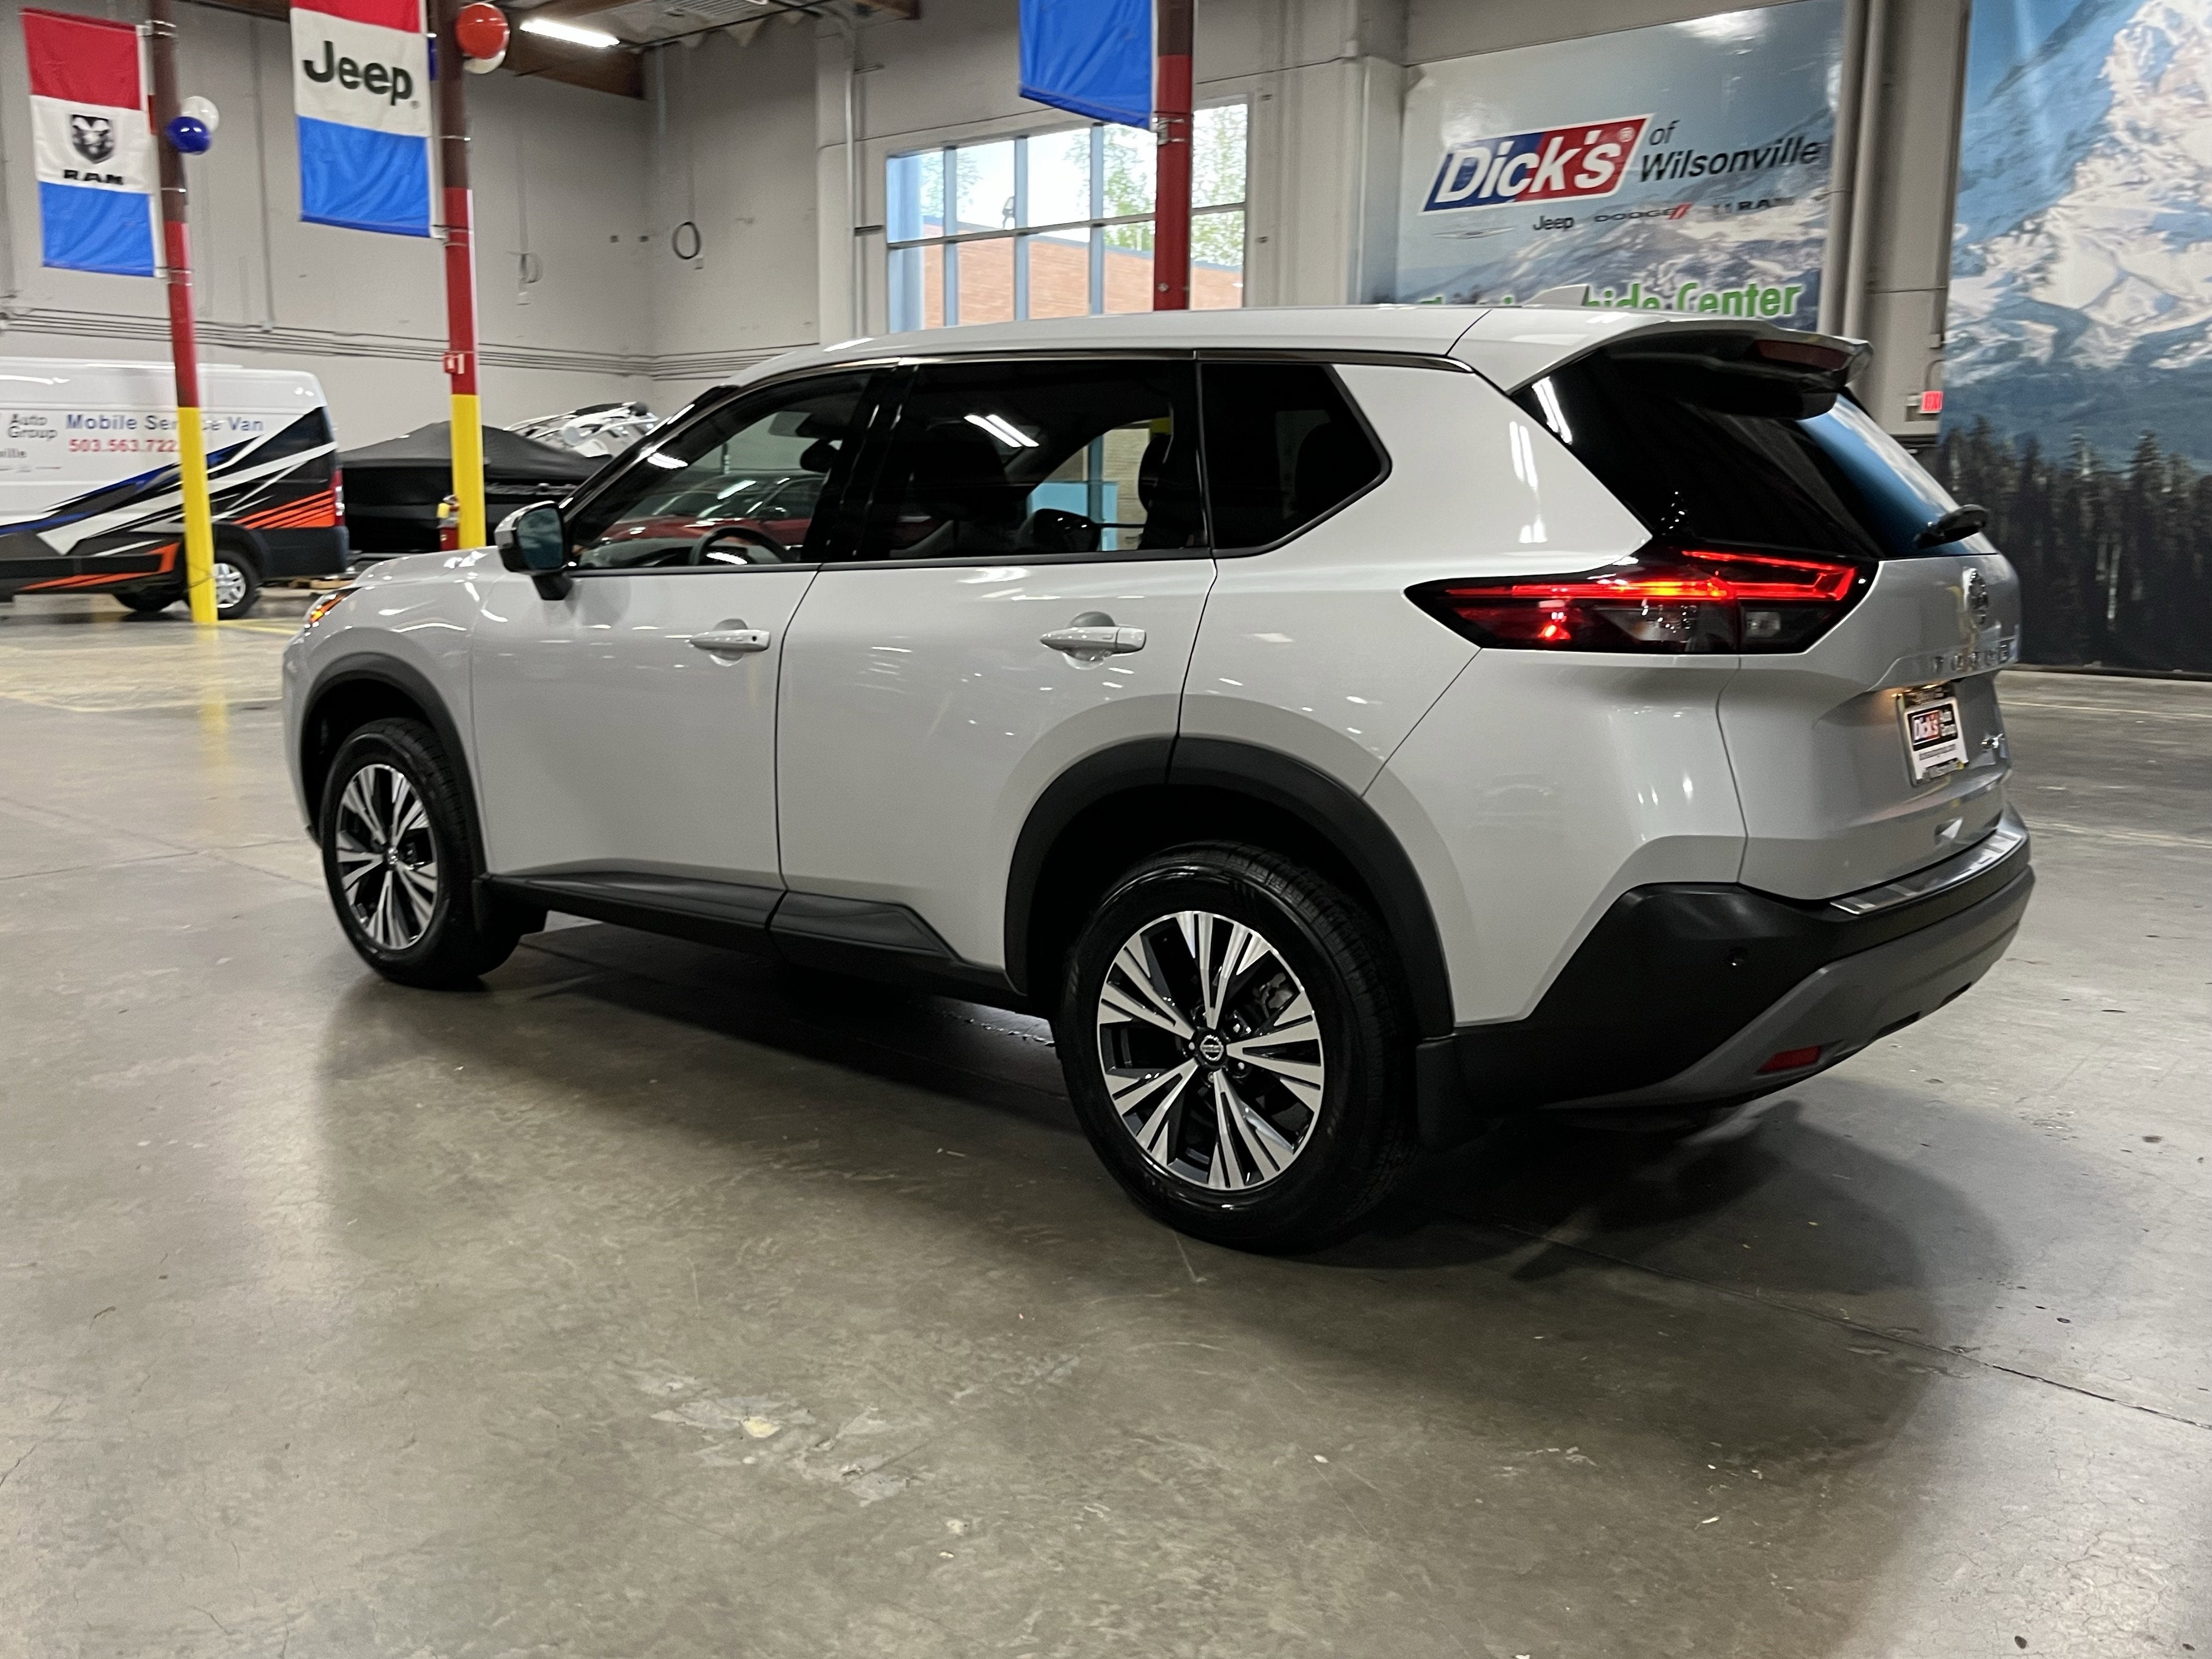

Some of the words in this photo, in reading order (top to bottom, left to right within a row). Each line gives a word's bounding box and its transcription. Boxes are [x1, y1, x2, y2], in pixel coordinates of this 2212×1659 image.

[303, 40, 414, 106] Jeep
[1649, 119, 1680, 145] of
[1434, 129, 1622, 204] Dick's
[1639, 136, 1822, 182] Wilsonville
[64, 169, 123, 185] RAM
[1594, 207, 1677, 222] DODGE
[1533, 216, 1574, 231] Jeep
[1677, 282, 1803, 317] Center
[10, 414, 48, 426] Auto
[66, 414, 137, 430] Mobile
[228, 416, 264, 431] Van
[8, 426, 58, 442] Group
[69, 438, 178, 453] 503.563.722
